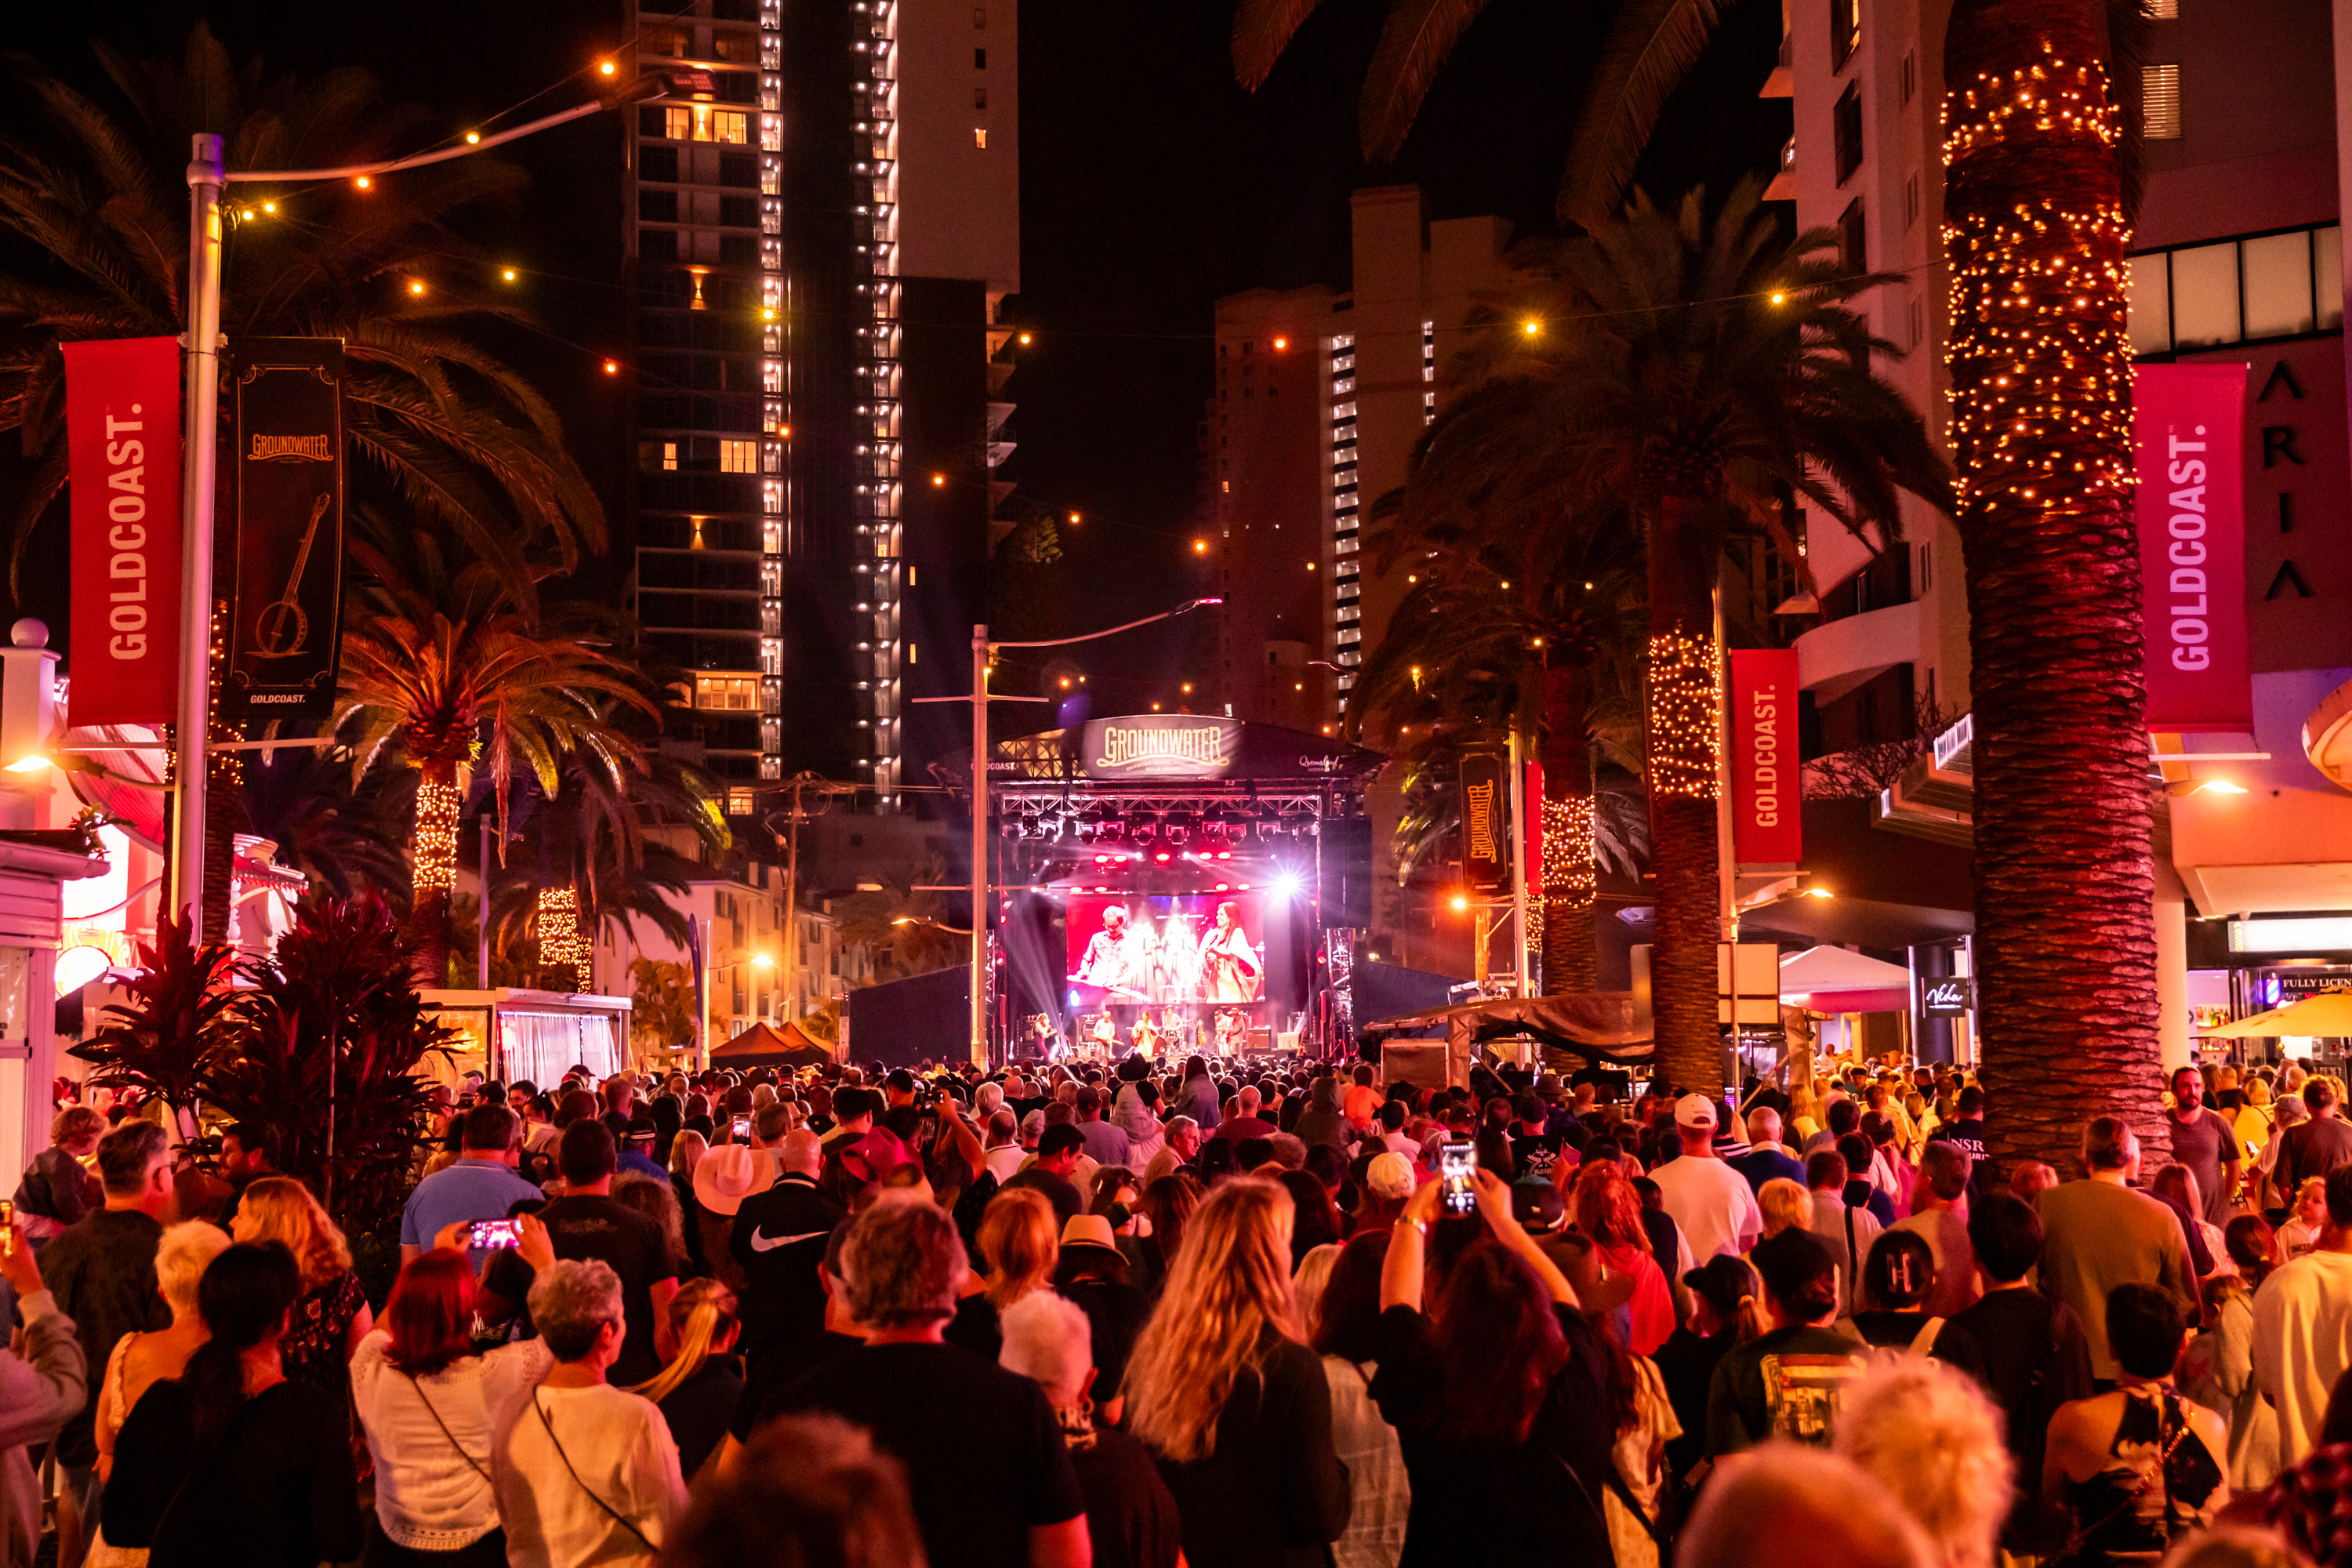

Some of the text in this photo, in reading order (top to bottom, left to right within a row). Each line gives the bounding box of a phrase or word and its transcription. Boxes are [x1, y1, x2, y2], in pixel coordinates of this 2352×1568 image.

[250, 434, 331, 460] GROUNDWATER
[106, 403, 147, 660] GOLDCOAST.
[2168, 424, 2210, 671] GOLDCOAST.
[250, 694, 306, 704] GOLDCOAST.
[1102, 726, 1225, 765] GROUNDWATER
[1754, 684, 1778, 827] GOLDCOAST.
[1126, 761, 1152, 771] COUNTRY
[1468, 782, 1495, 861] GROUNDWATER
[2283, 979, 2317, 988] FULLY
